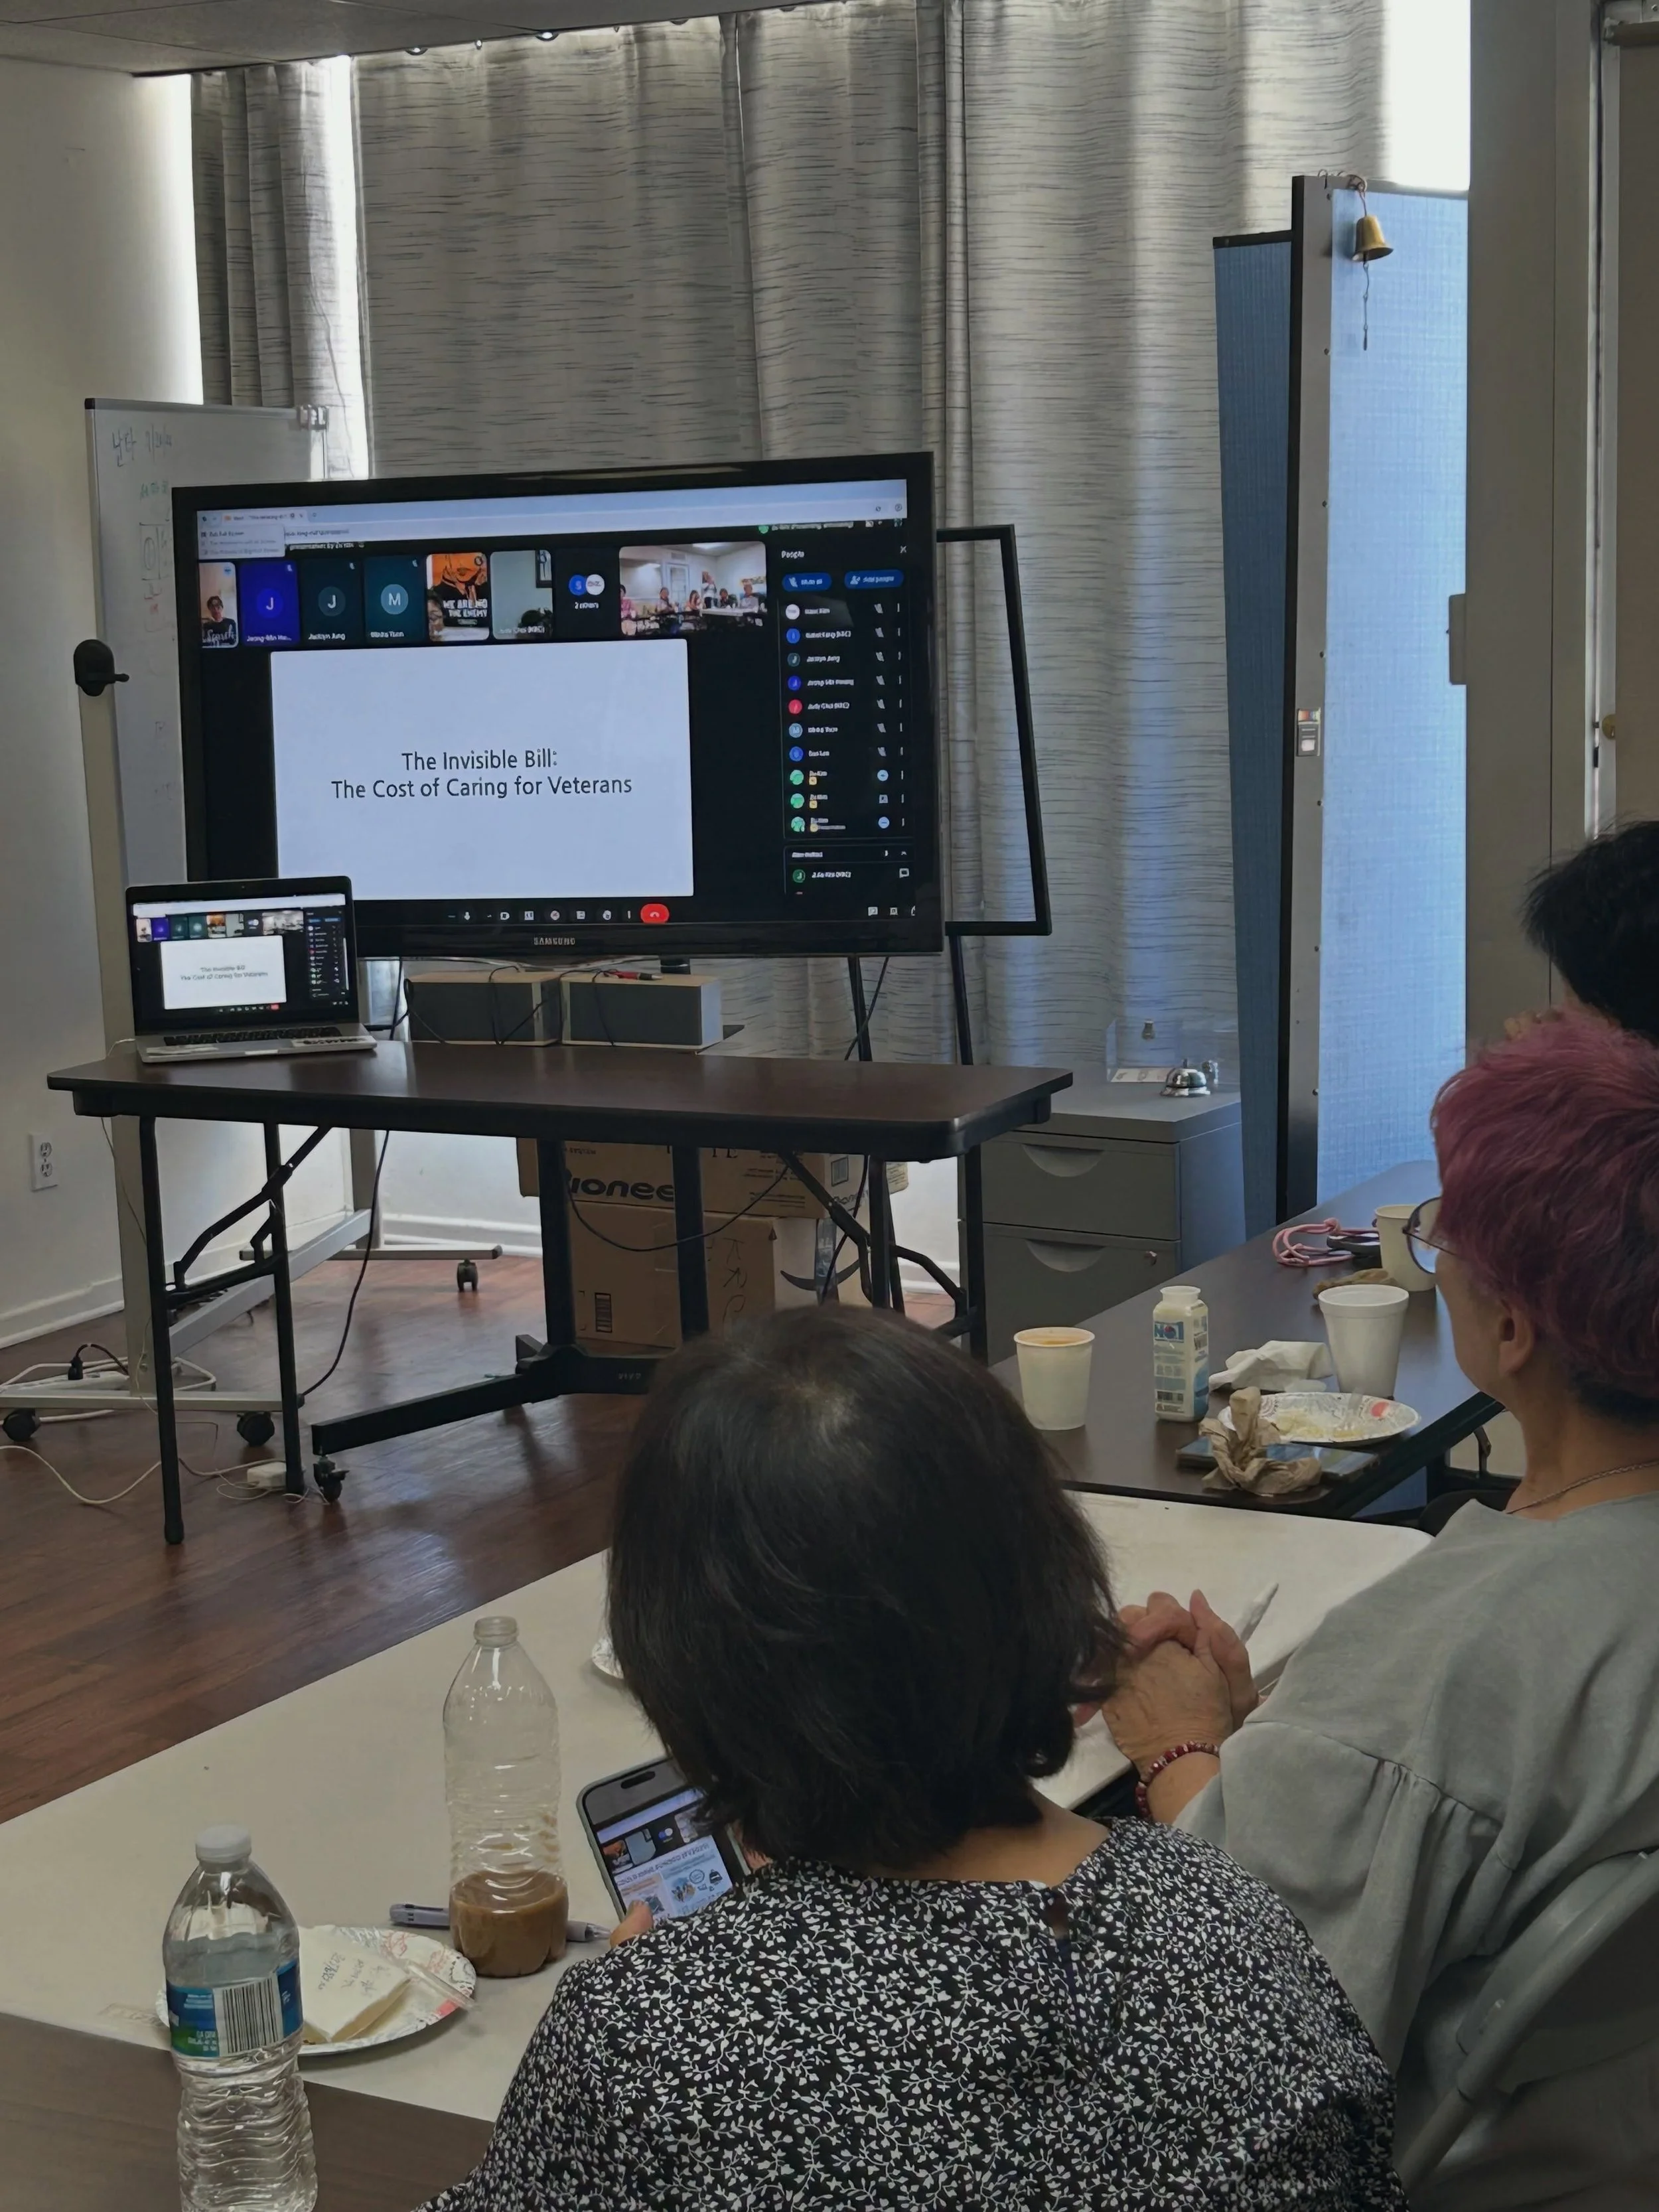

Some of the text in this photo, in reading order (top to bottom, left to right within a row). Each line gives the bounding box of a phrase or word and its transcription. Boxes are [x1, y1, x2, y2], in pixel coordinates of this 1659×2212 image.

[265, 597, 274, 611] J
[327, 595, 336, 609] J
[388, 593, 401, 606] M
[401, 747, 558, 771] The Invisible Bill:
[332, 775, 632, 799] The Cost of Caring for Veterans
[534, 936, 576, 946] SAMSUNG
[566, 1169, 675, 1202] ionee
